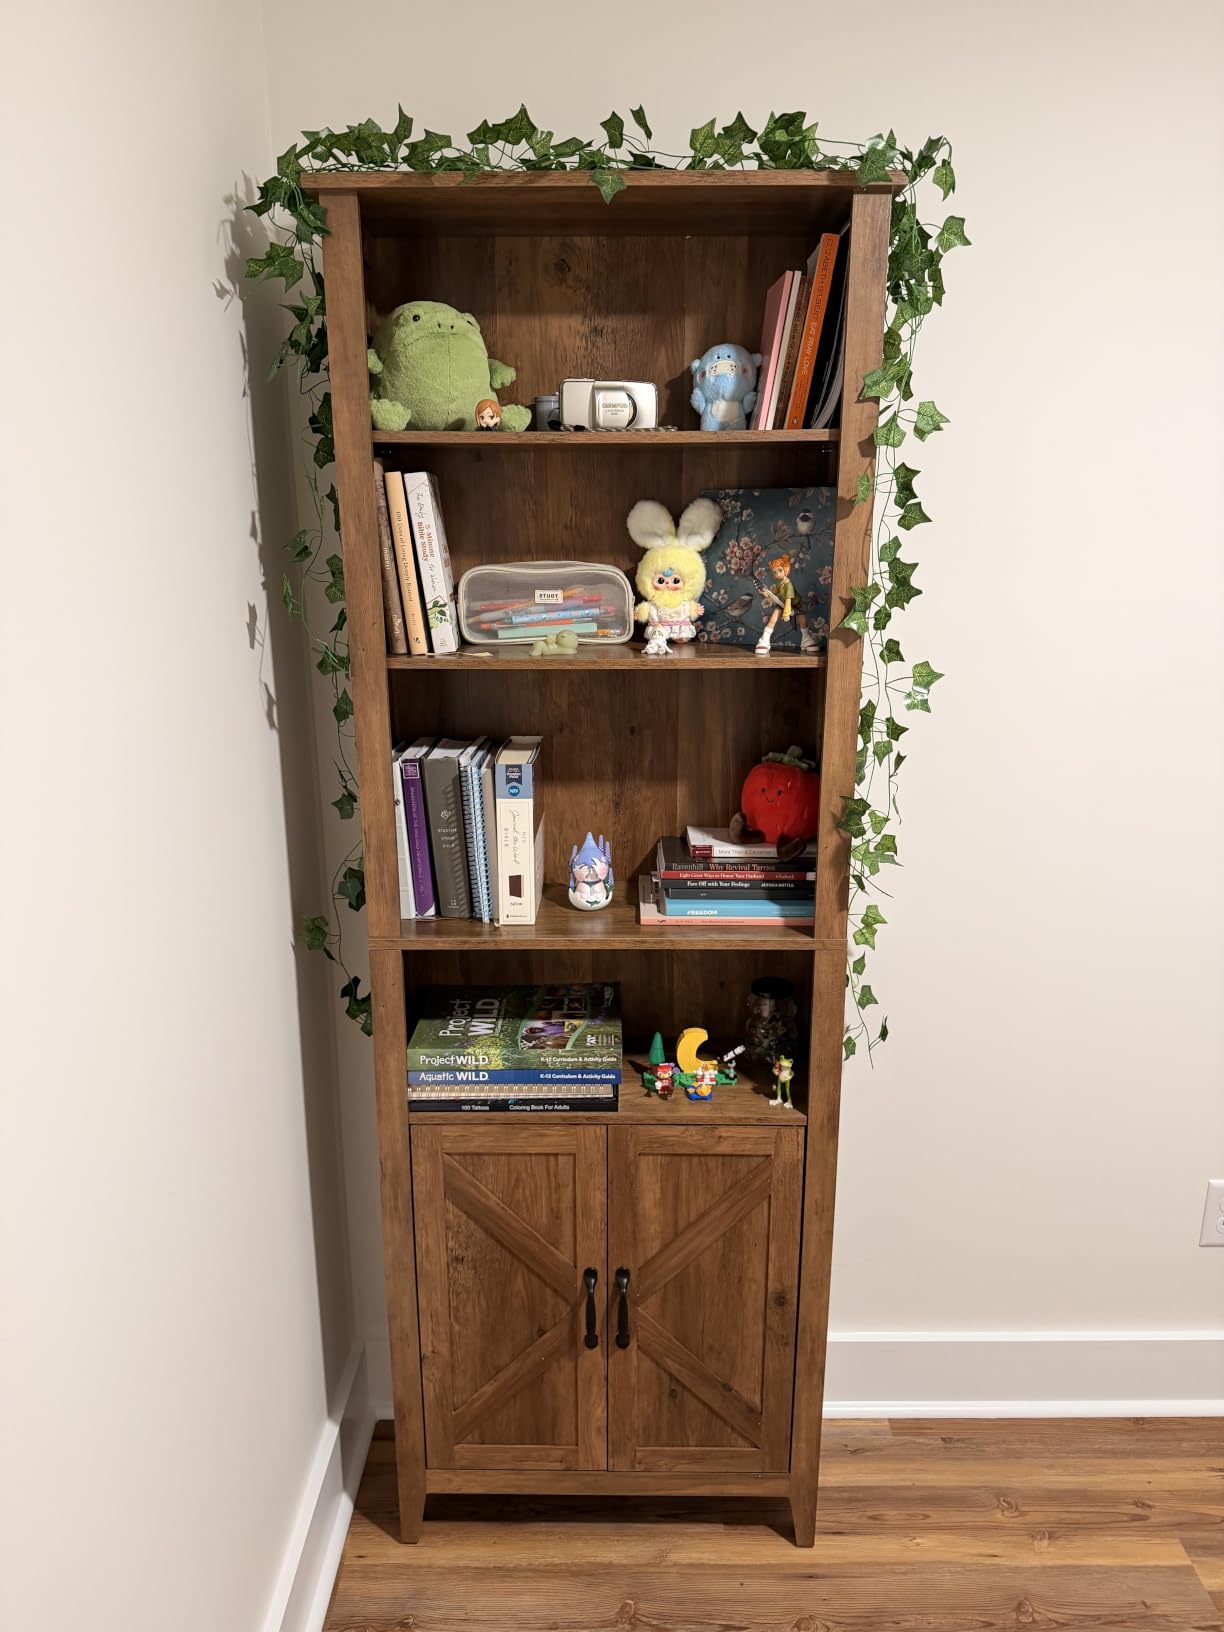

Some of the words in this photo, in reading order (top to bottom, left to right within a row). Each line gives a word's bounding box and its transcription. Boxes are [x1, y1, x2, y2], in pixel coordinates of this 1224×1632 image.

[806, 336, 814, 355] PRAY
[802, 357, 810, 376] LOVE
[421, 541, 429, 562] Study
[710, 863, 723, 871] Why
[726, 863, 750, 871] Revival
[439, 999, 472, 1037] Project
[468, 999, 500, 1037] WILD
[420, 1055, 455, 1066] Project
[456, 1055, 489, 1065] WILD
[419, 1072, 455, 1082] Aquatic
[456, 1072, 489, 1081] WILD
